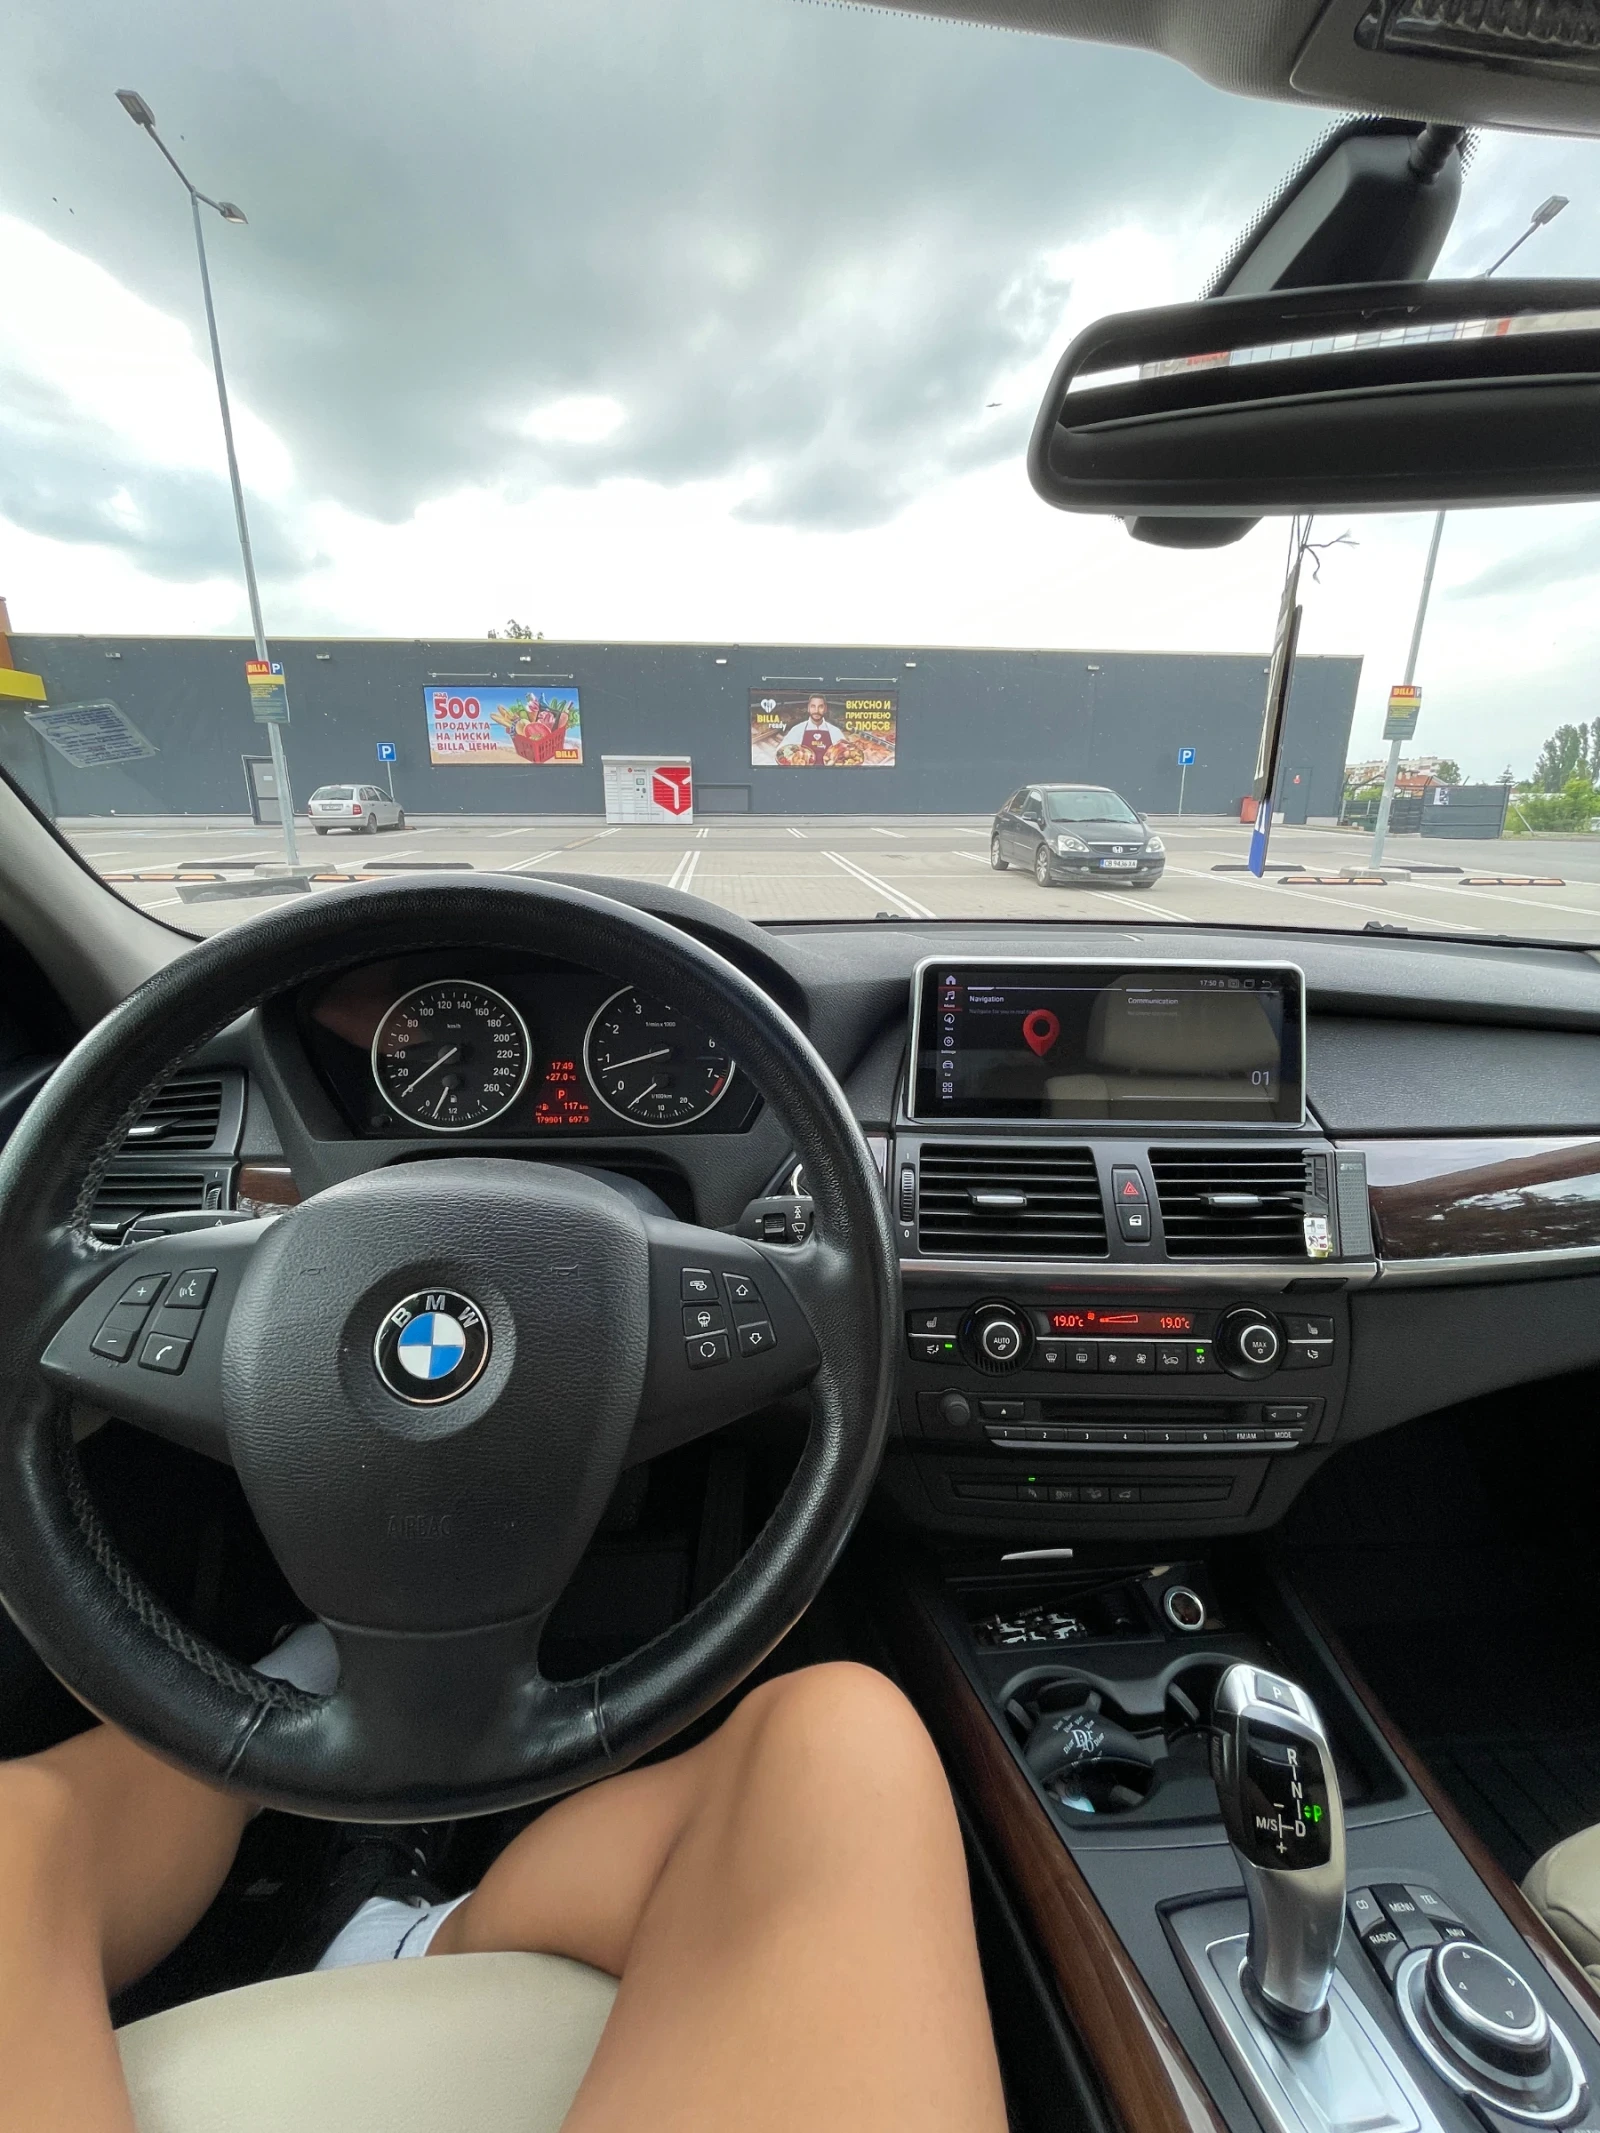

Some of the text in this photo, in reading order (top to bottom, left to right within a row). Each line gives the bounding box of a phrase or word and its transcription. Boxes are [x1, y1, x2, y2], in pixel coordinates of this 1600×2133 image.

[248, 664, 269, 673] BILLA
[272, 663, 281, 674] P
[433, 697, 481, 720] 500
[845, 700, 891, 710] ВКУСНО И
[757, 714, 780, 723] BILLA
[845, 711, 891, 720] ПРИГОТВЕНО
[435, 722, 491, 731] ПРОДУКТА
[768, 721, 787, 731] ready
[845, 721, 853, 731] С
[436, 732, 491, 741] НА НИСКИ
[437, 742, 498, 752] BILLA ЦЕНИ
[381, 745, 392, 759] P
[555, 750, 577, 759] BILLA
[1182, 750, 1192, 762] P
[969, 995, 1005, 1004] Navigation
[1127, 997, 1179, 1005] Communication
[437, 1001, 452, 1009] 120
[457, 1001, 472, 1009] 140
[635, 1005, 642, 1014] 3
[419, 1008, 434, 1016] 100
[475, 1008, 489, 1016] 160
[407, 1020, 418, 1028] 80
[612, 1025, 619, 1034] 2
[398, 1034, 409, 1043] 60
[493, 1034, 510, 1042] 200
[708, 1038, 716, 1048] 6
[394, 1051, 405, 1059] 40
[497, 1051, 513, 1059] 220
[605, 1053, 610, 1063] 1
[551, 1062, 574, 1070] 17:49
[398, 1069, 409, 1077] 20
[493, 1068, 510, 1076] 240
[707, 1068, 713, 1078] 7
[1251, 1070, 1270, 1086] 01
[484, 1084, 500, 1092] 260
[617, 1080, 625, 1090] 0
[558, 1090, 565, 1099] P
[563, 1102, 579, 1110] 117
[391, 1295, 479, 1328] BMW
[993, 1337, 1010, 1345] AUTO
[1165, 1433, 1170, 1441] 5
[1274, 1431, 1292, 1439] MODE
[1273, 1686, 1281, 1699] P
[1286, 1747, 1298, 1766] R
[1290, 1781, 1303, 1799] N
[1313, 1804, 1323, 1823] P
[1256, 1816, 1278, 1832] M/S
[1295, 1820, 1306, 1837] D
[1420, 1894, 1438, 1905] TEL
[1356, 1899, 1369, 1911] CD
[1388, 1901, 1415, 1913] MENU
[1369, 1931, 1397, 1944] RADIO
[1446, 1928, 1466, 1938] NAV
